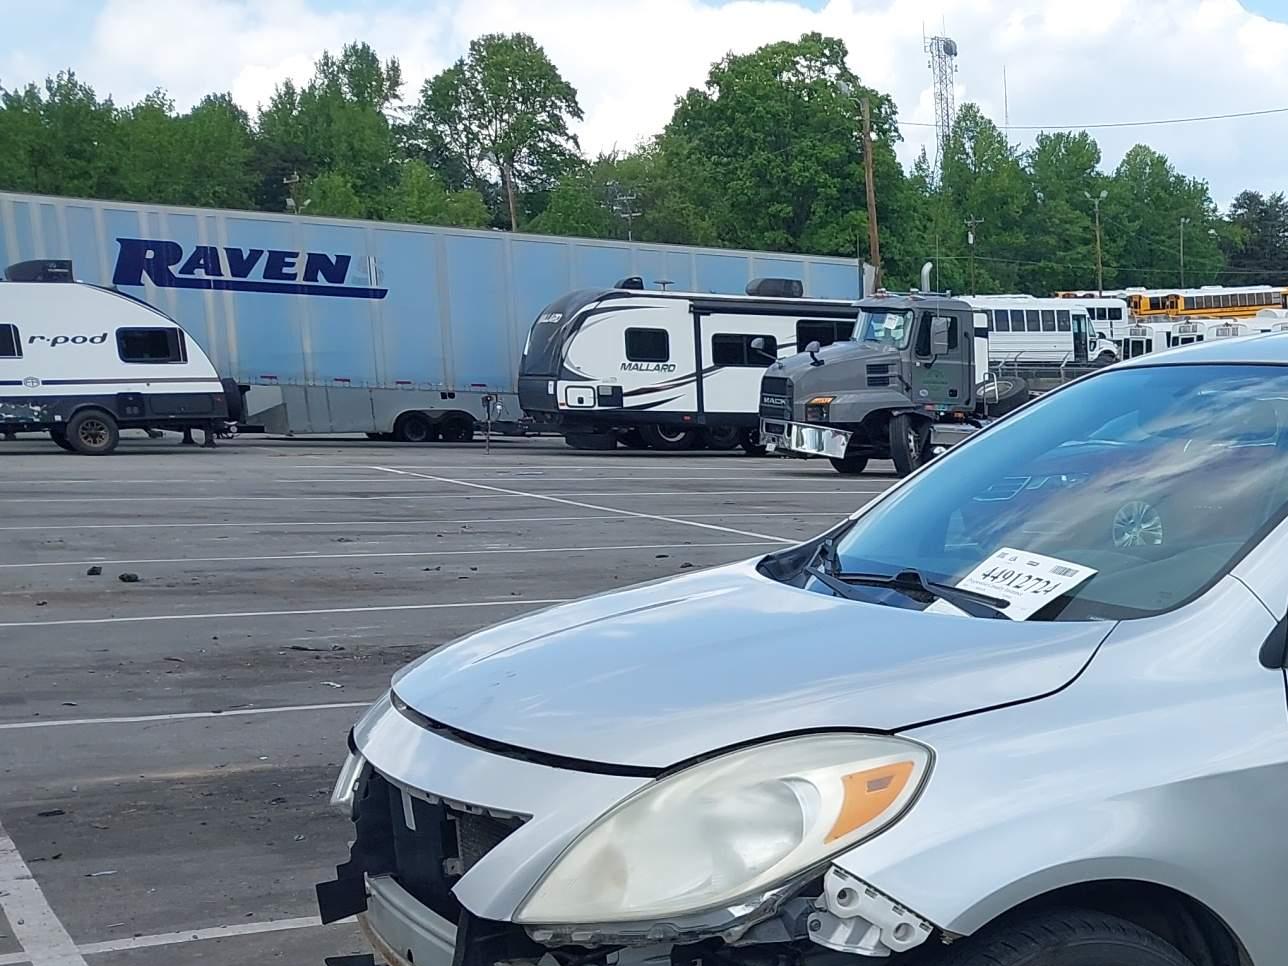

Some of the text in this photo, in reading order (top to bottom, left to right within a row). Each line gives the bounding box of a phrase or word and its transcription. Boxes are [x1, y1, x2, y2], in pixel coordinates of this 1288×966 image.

[112, 237, 352, 288] RAVEN
[620, 362, 676, 372] MALLARD
[982, 566, 1062, 595] 44912724
